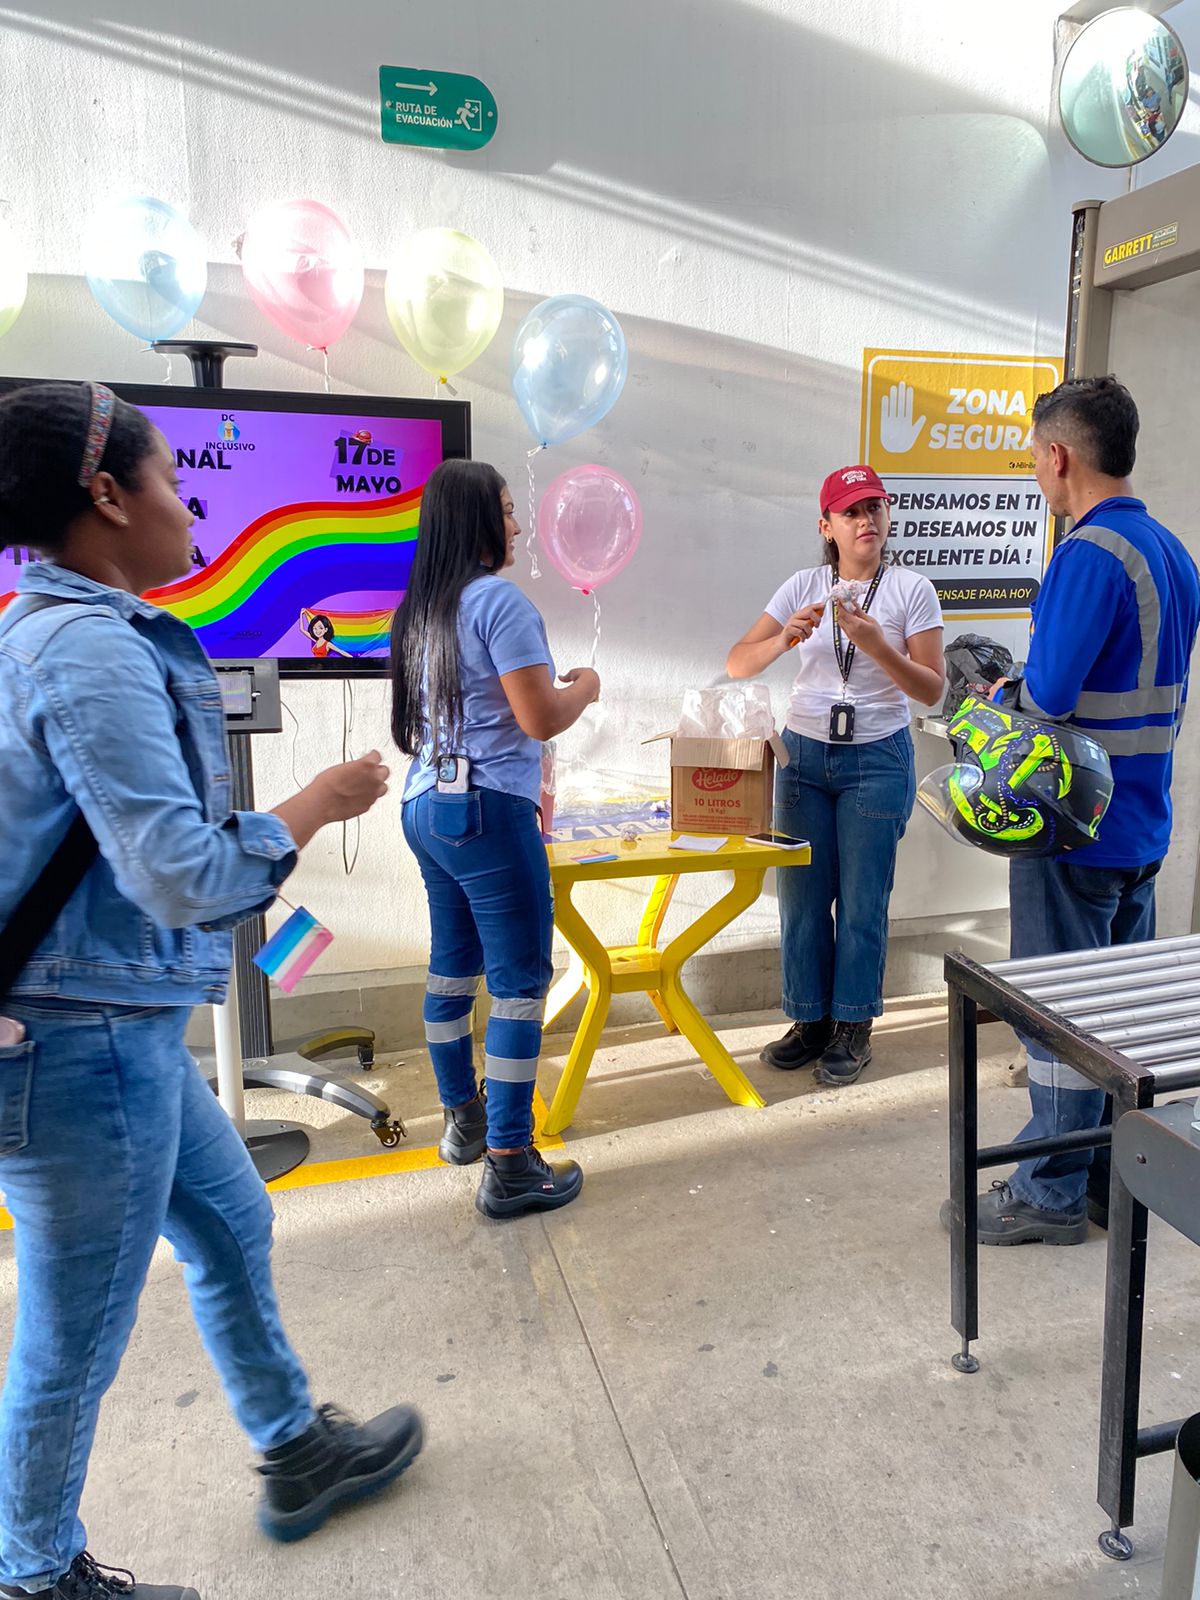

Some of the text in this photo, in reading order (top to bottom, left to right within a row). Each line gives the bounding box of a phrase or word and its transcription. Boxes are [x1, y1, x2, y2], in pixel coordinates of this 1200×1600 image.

[396, 102, 437, 116] RUTA DE
[396, 114, 453, 128] EVACUACIÓN
[1104, 233, 1153, 264] GARRETT
[947, 388, 1026, 416] ZONA
[221, 414, 235, 422] DC
[205, 442, 256, 451] INCLUSIVO
[335, 436, 396, 466] 17 DE
[336, 475, 402, 494] MAYO
[888, 493, 1042, 510] PENSAMOS EN TI
[887, 521, 1037, 537] E DESEAMOS UN
[989, 544, 1020, 565] DÍA
[1025, 549, 1032, 565] !
[937, 588, 1032, 600] ENSAJE PARA HOY
[696, 770, 738, 787] Helado
[695, 798, 742, 808] 10 LITROS
